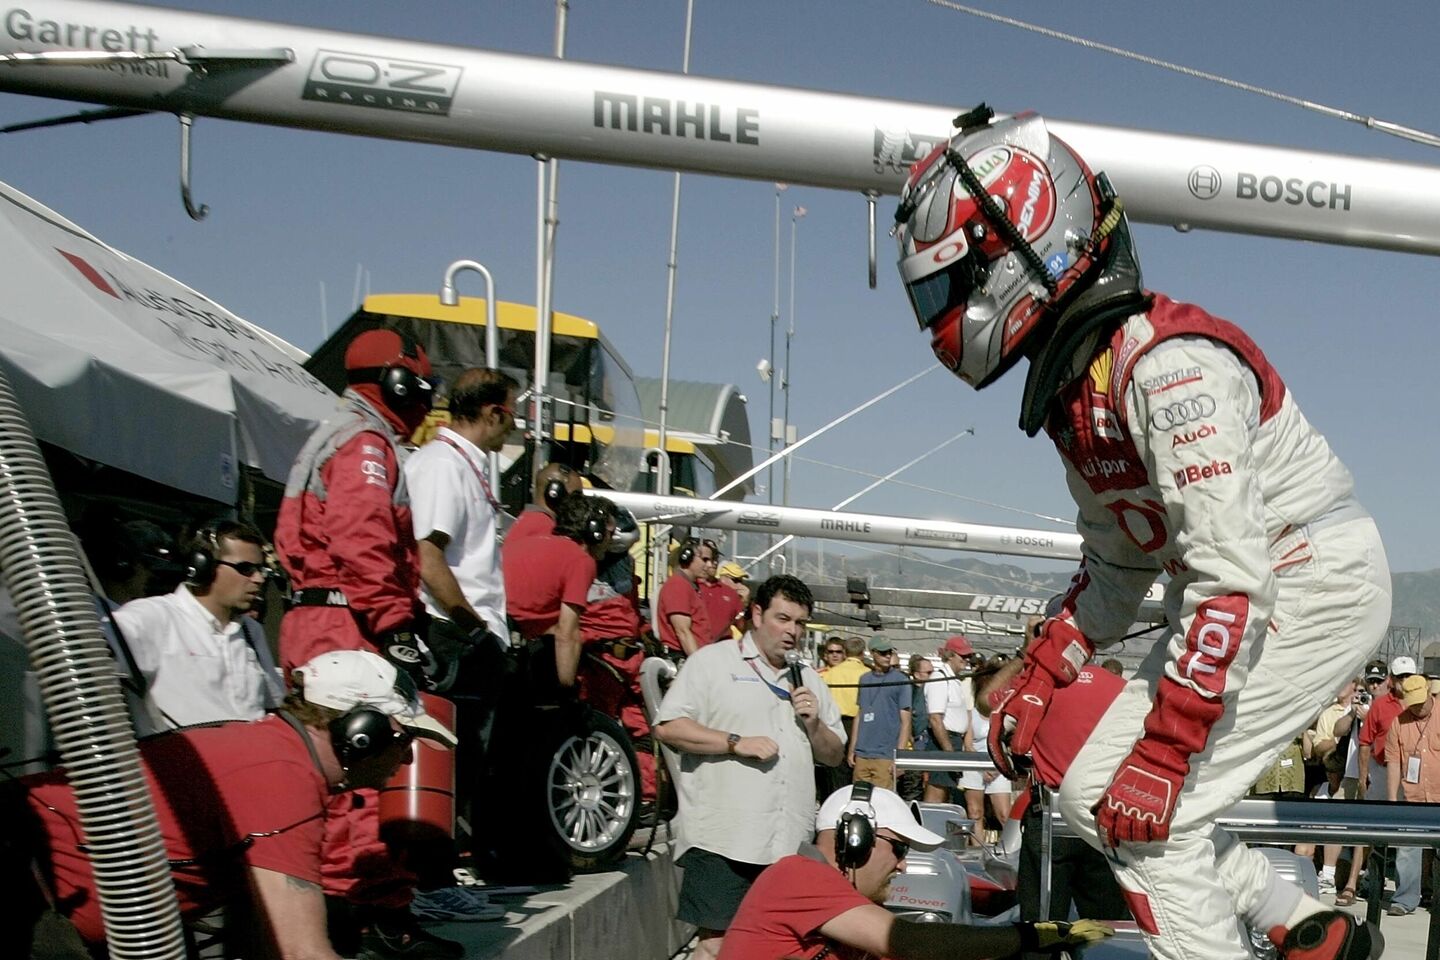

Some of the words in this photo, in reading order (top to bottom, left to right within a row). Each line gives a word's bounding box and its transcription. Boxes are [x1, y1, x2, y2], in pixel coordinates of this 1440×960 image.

[6, 8, 159, 54] Garrett
[594, 90, 759, 146] MAHLE
[1236, 172, 1352, 212] BOSCH
[1171, 424, 1217, 449] Audi
[1186, 460, 1233, 484] Beta
[654, 502, 695, 514] Garrett
[820, 518, 871, 533] MAHLE
[1015, 536, 1054, 548] BOSCH
[1186, 608, 1236, 678] TDI
[899, 895, 949, 907] Power
